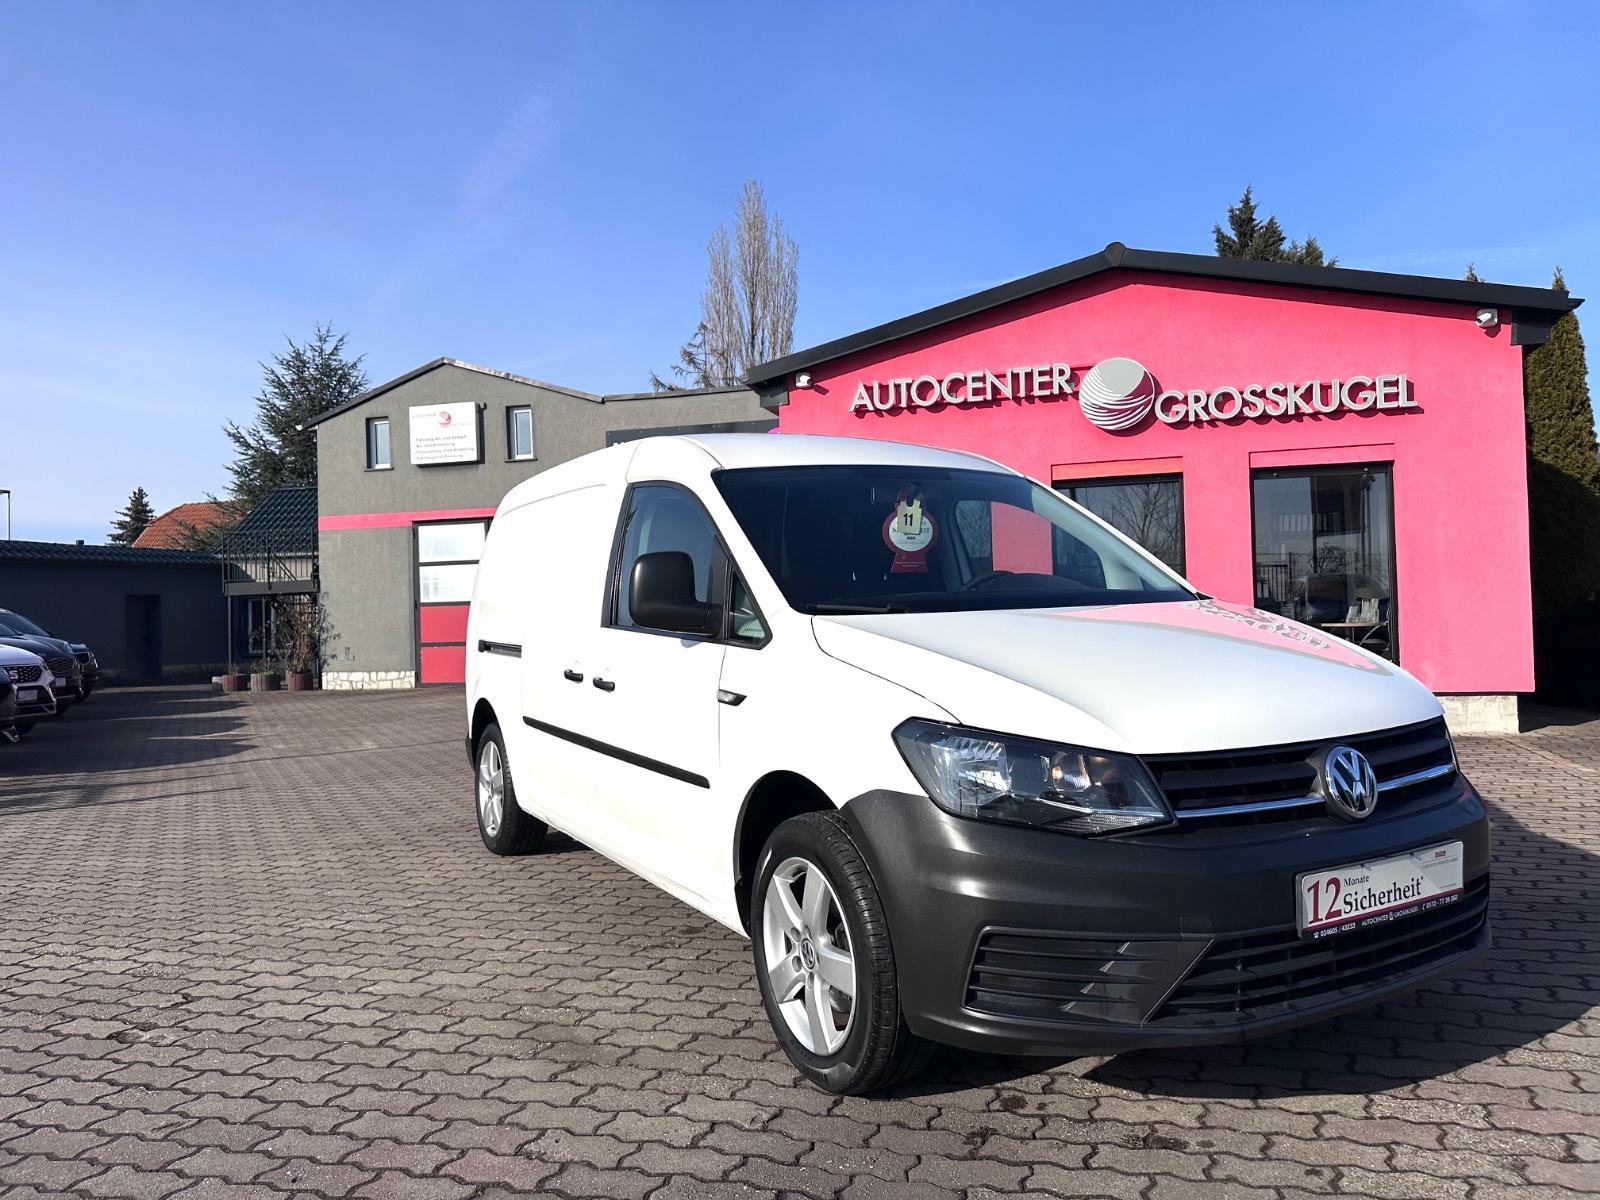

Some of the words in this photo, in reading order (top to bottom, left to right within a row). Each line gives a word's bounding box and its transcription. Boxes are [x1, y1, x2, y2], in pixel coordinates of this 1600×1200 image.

[849, 363, 1073, 412] AUTOCENTER
[1154, 374, 1417, 424] GROSSKUGEL
[903, 513, 914, 526] 11
[1344, 874, 1370, 887] Monate
[1307, 876, 1343, 925] 12
